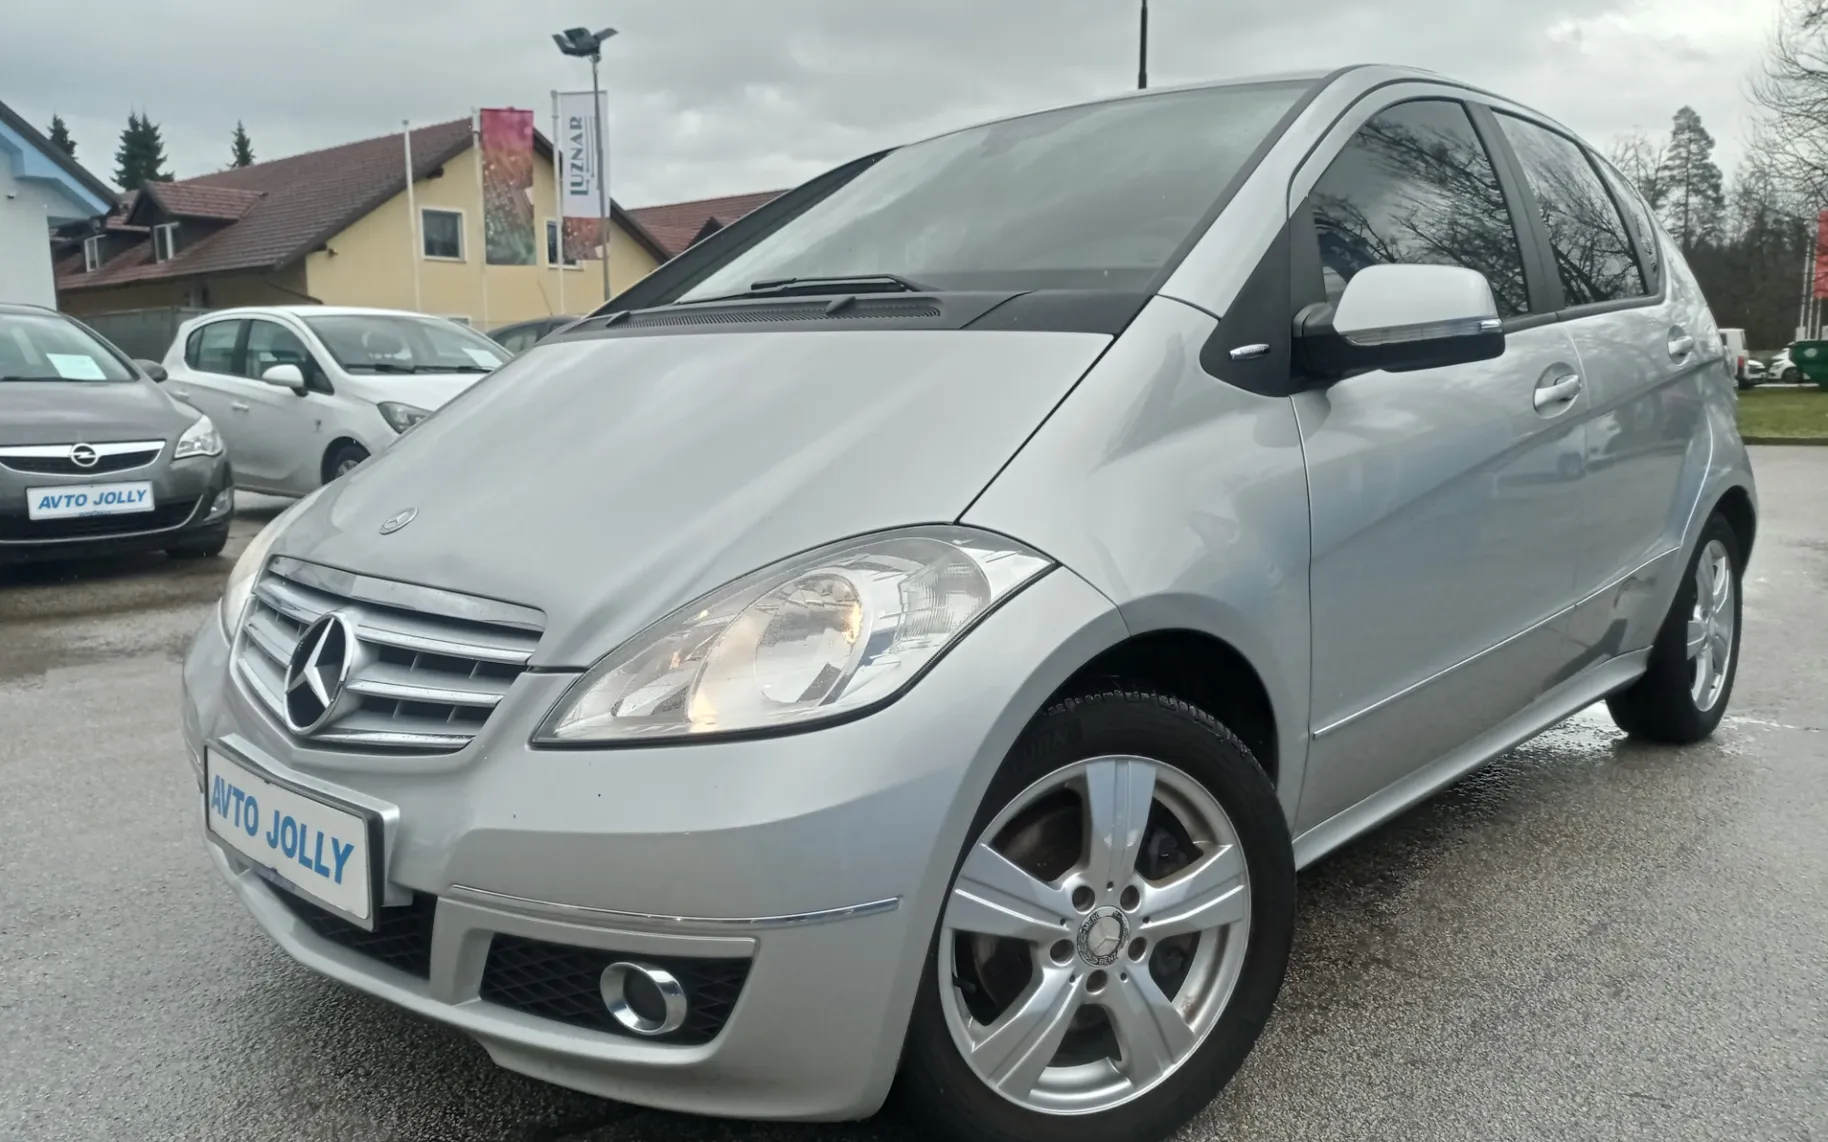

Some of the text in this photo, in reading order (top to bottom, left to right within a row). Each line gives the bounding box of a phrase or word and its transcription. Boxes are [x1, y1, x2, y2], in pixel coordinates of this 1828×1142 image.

[570, 115, 589, 196] LUZNAR
[38, 489, 147, 510] AVTO JOLLY
[211, 774, 355, 885] AVTO JOLLY
